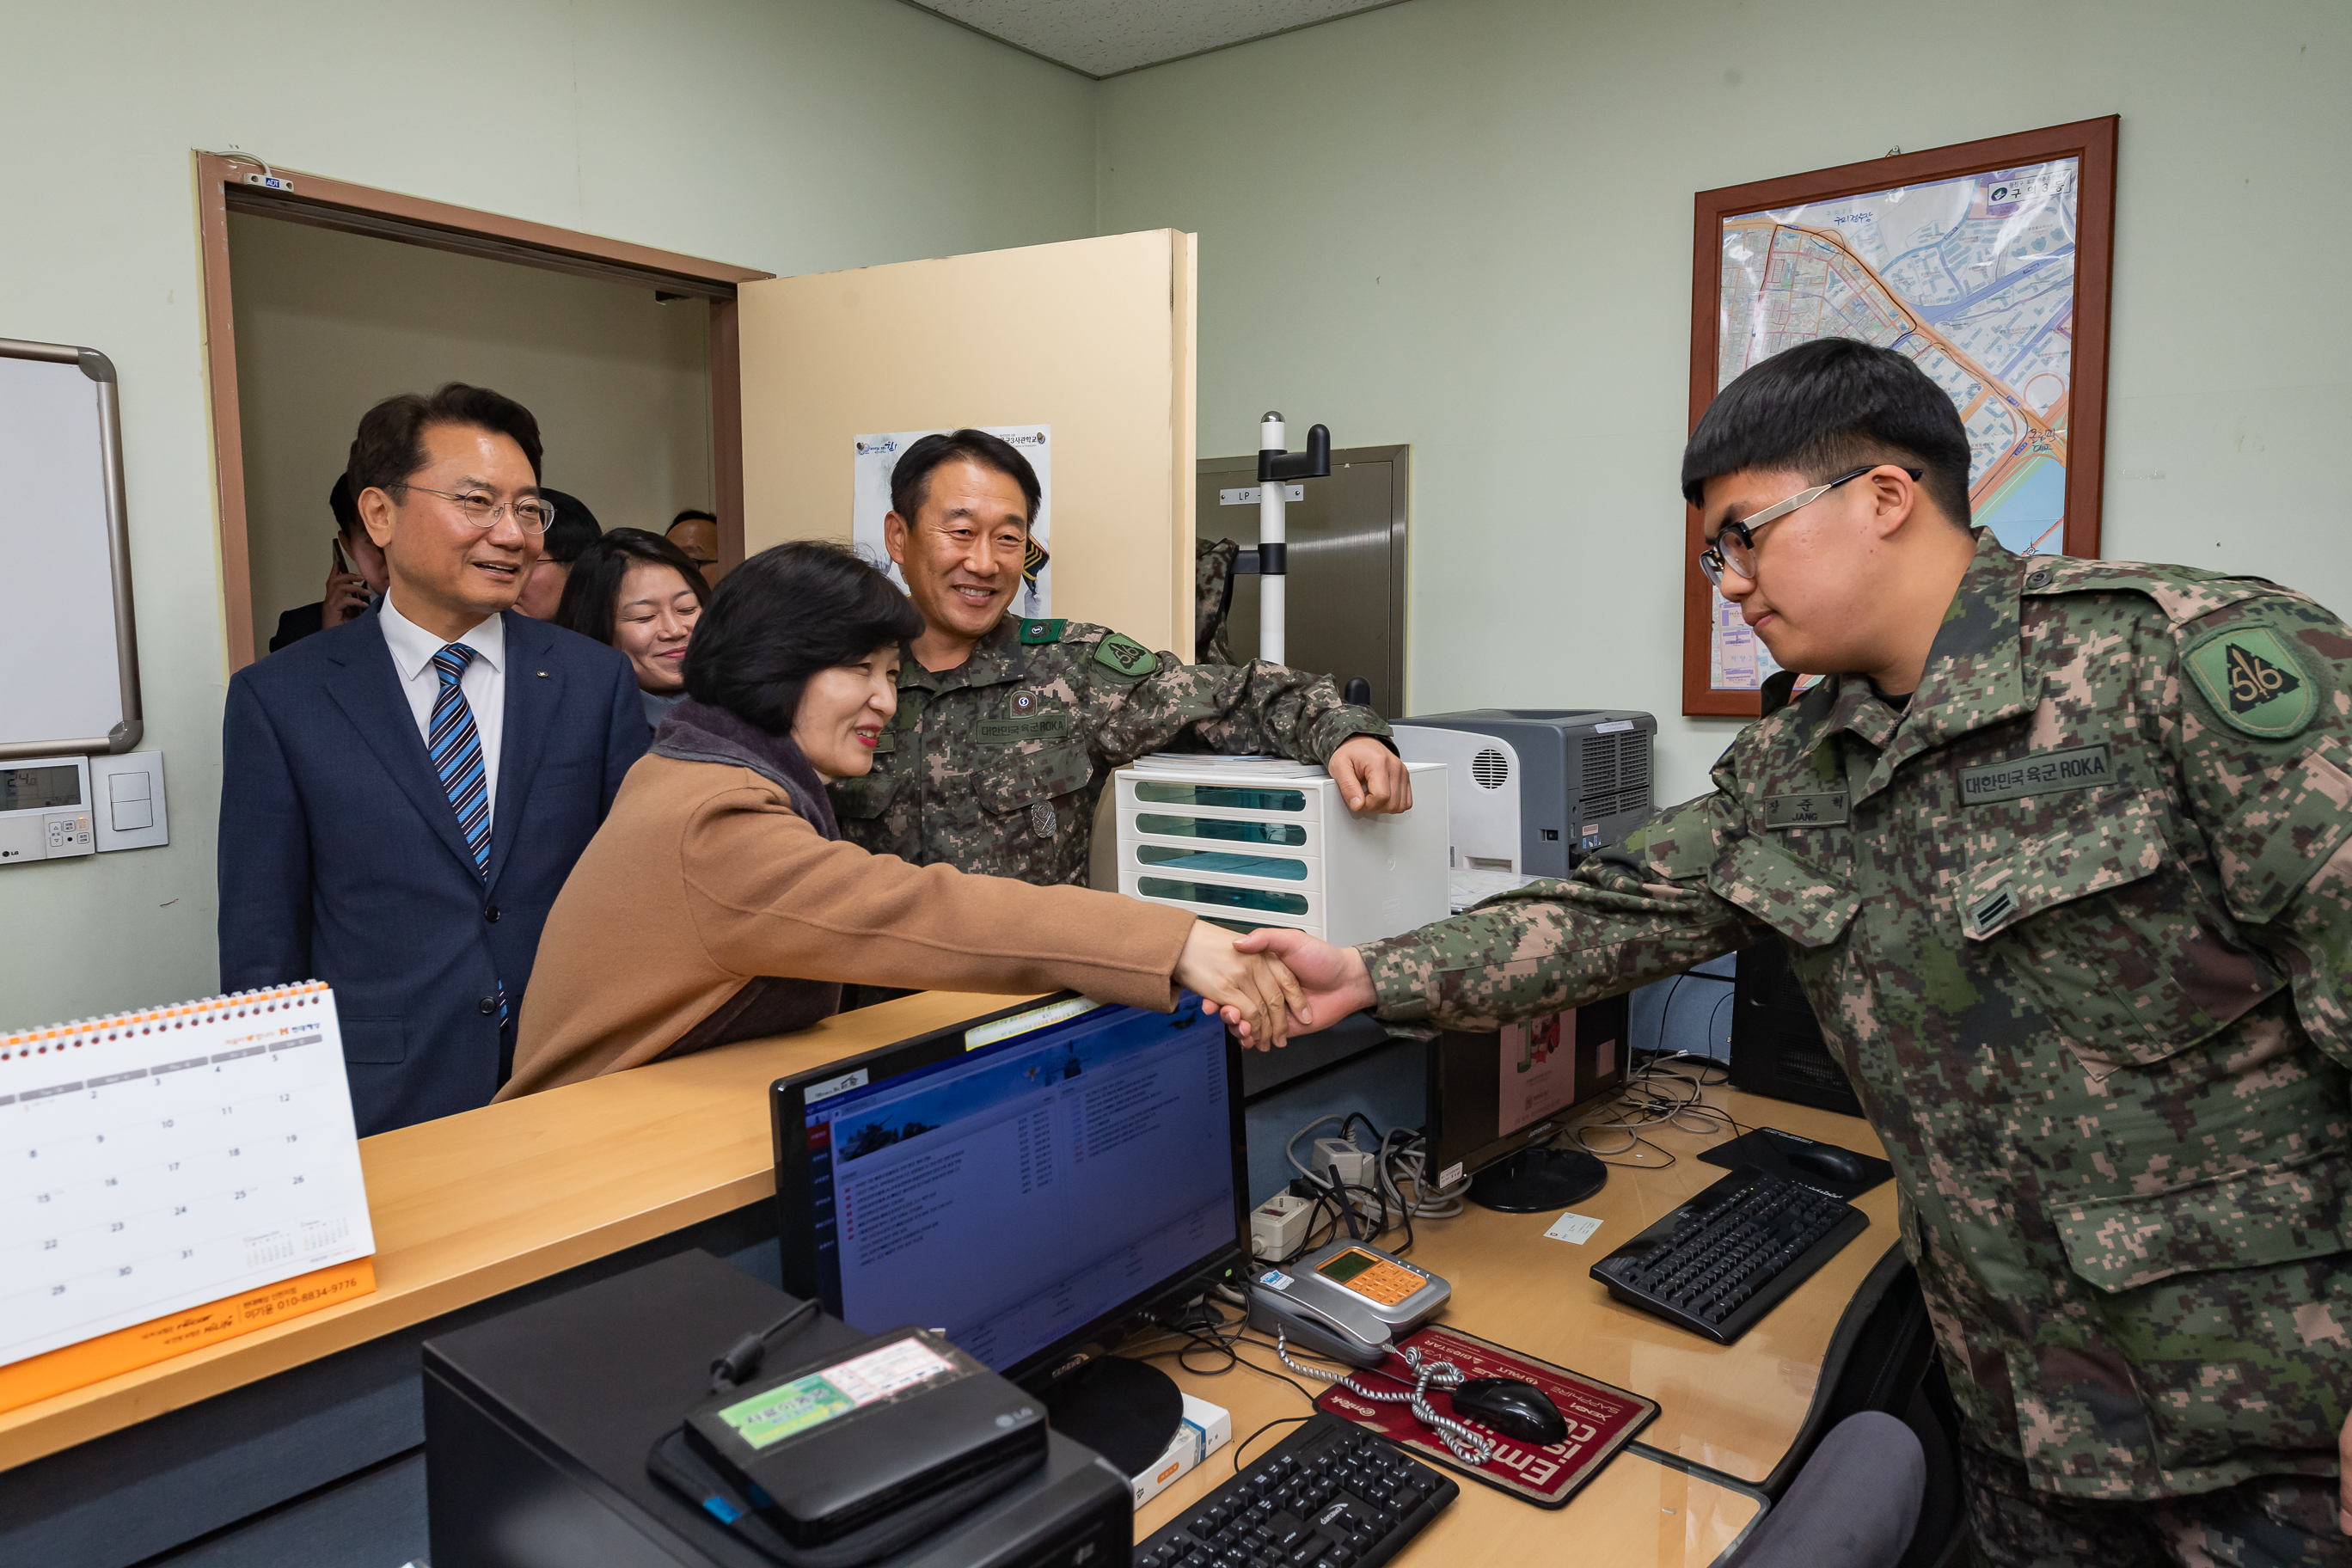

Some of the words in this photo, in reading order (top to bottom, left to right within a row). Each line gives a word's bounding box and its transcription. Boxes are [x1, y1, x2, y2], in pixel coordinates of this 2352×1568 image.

[266, 179, 279, 187] ADT
[1239, 492, 1249, 500] LP
[2232, 658, 2283, 701] 56
[982, 726, 1020, 738] 대한민국
[1021, 722, 1039, 733] 육군
[1040, 720, 1064, 732] ROKA
[1965, 769, 2024, 794] 대한민국
[2026, 763, 2058, 783] 육군
[2060, 756, 2106, 779] ROKA
[279, 1093, 291, 1102] 12
[222, 1106, 233, 1115] 11
[162, 1120, 175, 1129] 10
[286, 1134, 297, 1143] 19
[229, 1148, 241, 1157] 18
[168, 1161, 180, 1172] 17
[292, 1175, 305, 1185] 26
[235, 1190, 247, 1200] 25
[278, 1278, 358, 1310] 010-8834-9776
[1424, 1338, 1473, 1360] BIOSTAR
[1550, 1386, 1621, 1415] SAPPHIRE
[1320, 1506, 1344, 1525] danawa
